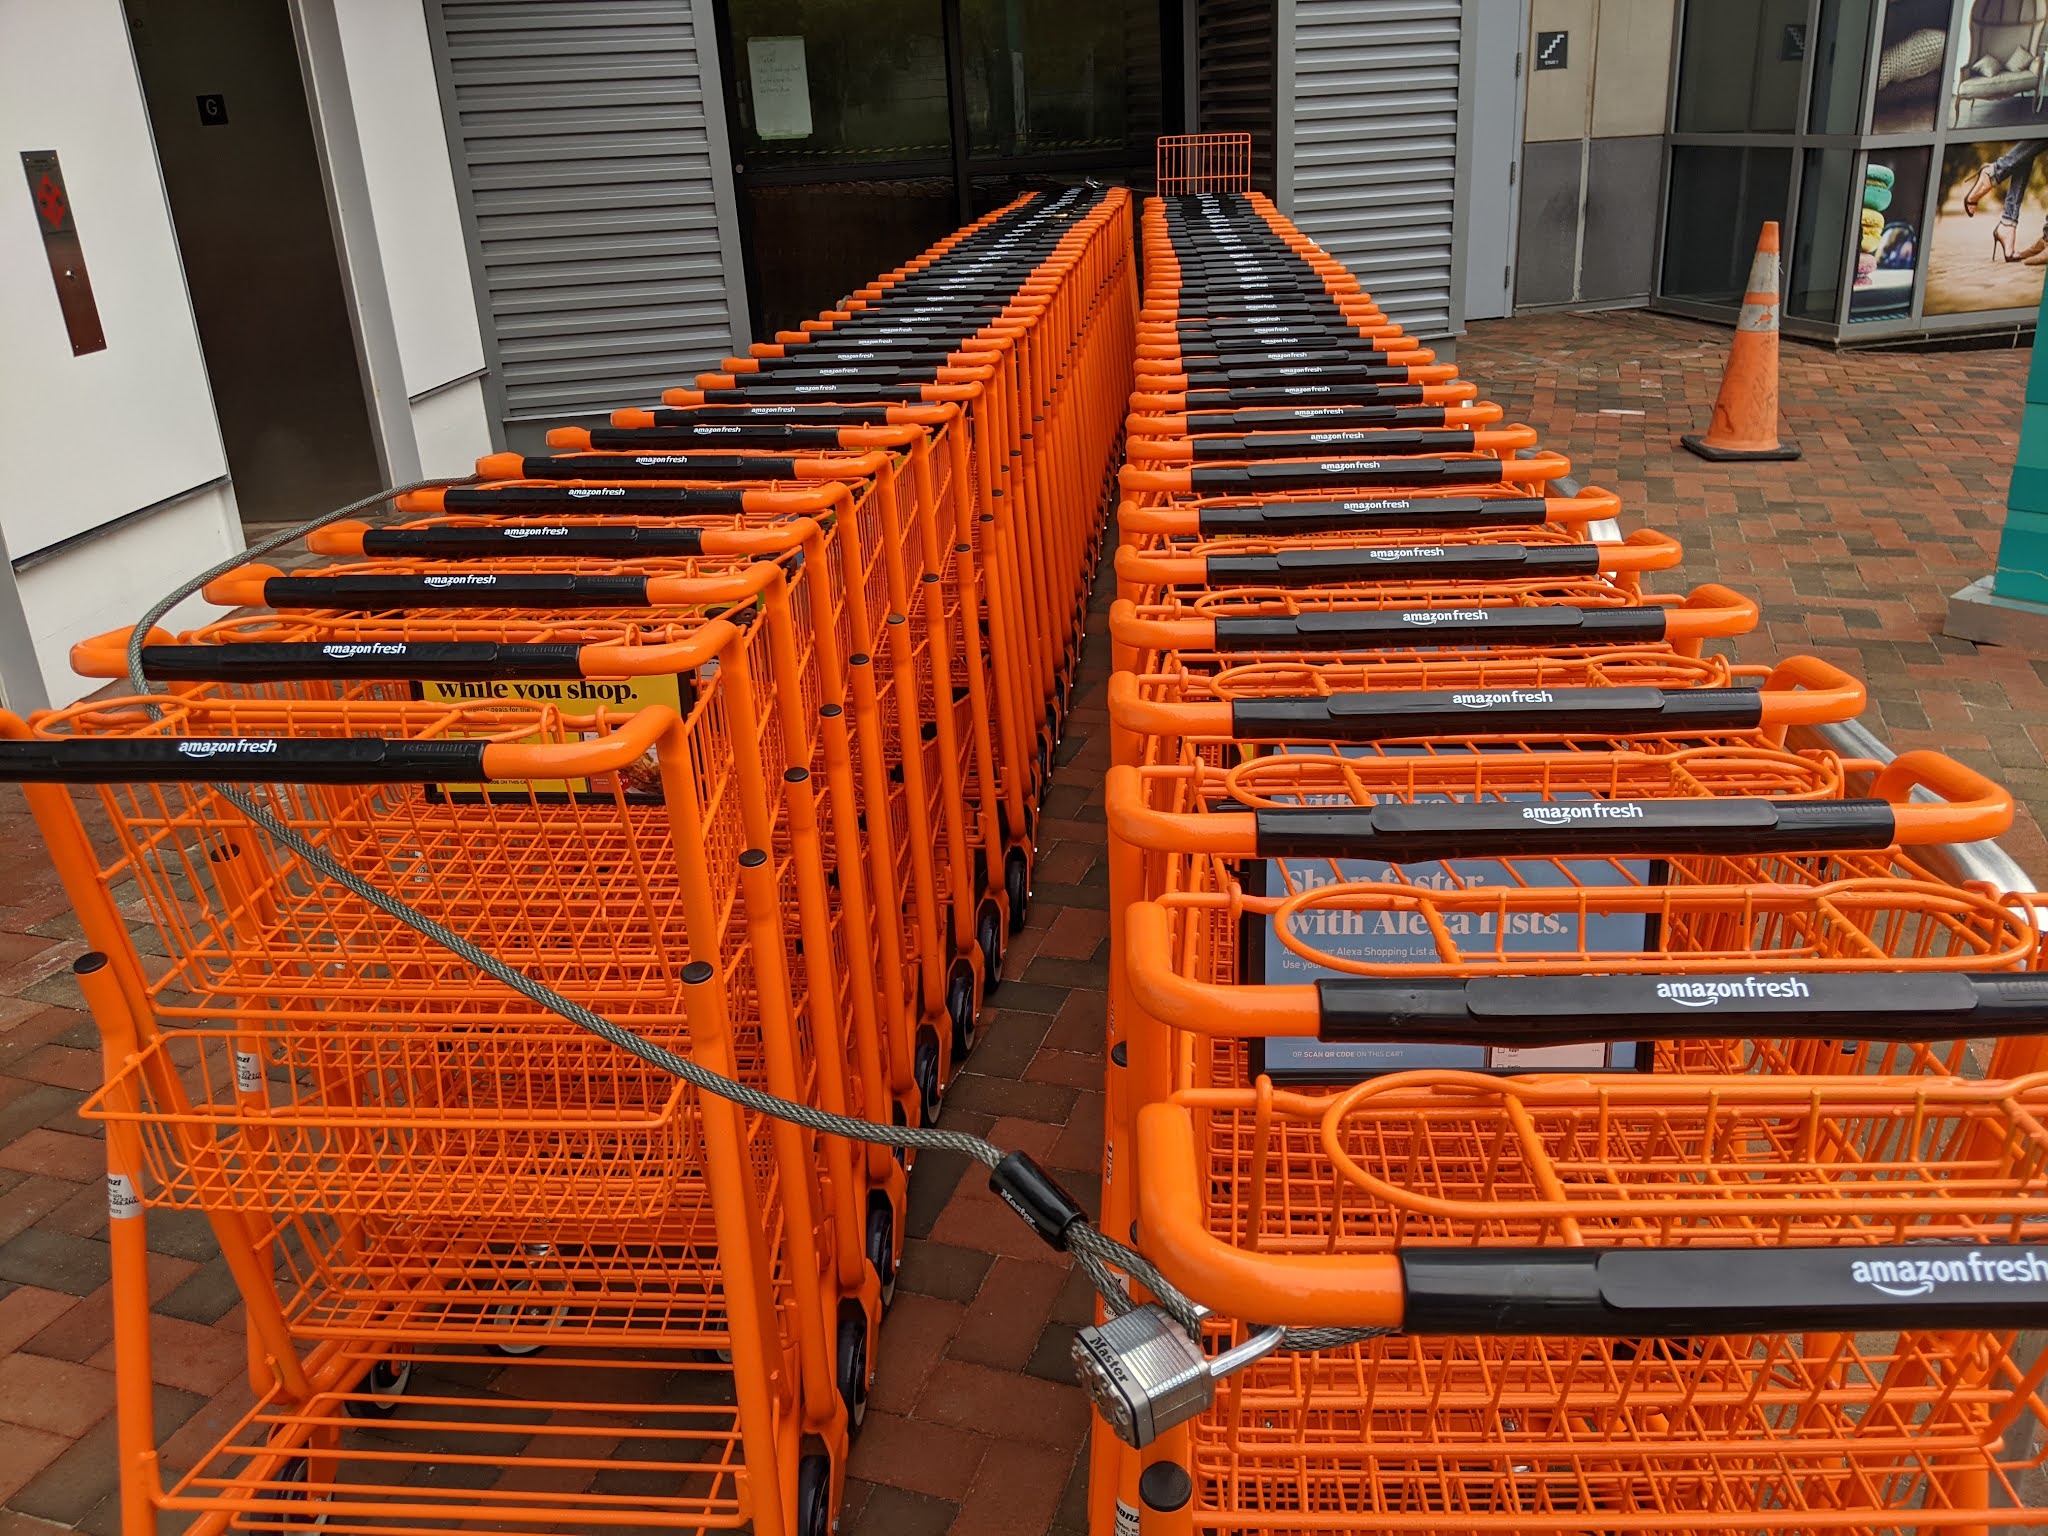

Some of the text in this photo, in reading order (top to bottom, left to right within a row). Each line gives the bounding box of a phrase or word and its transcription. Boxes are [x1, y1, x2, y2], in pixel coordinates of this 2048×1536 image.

[206, 99, 217, 115] G
[435, 681, 508, 698] while
[567, 681, 638, 704] shop.
[1287, 909, 1365, 935] with
[1283, 960, 1300, 968] Use
[1337, 947, 1362, 955] Alexa
[1364, 947, 1407, 958] Shopping
[1410, 947, 1427, 955] List
[1001, 1188, 1036, 1224] Master
[1089, 1336, 1130, 1383] Master
